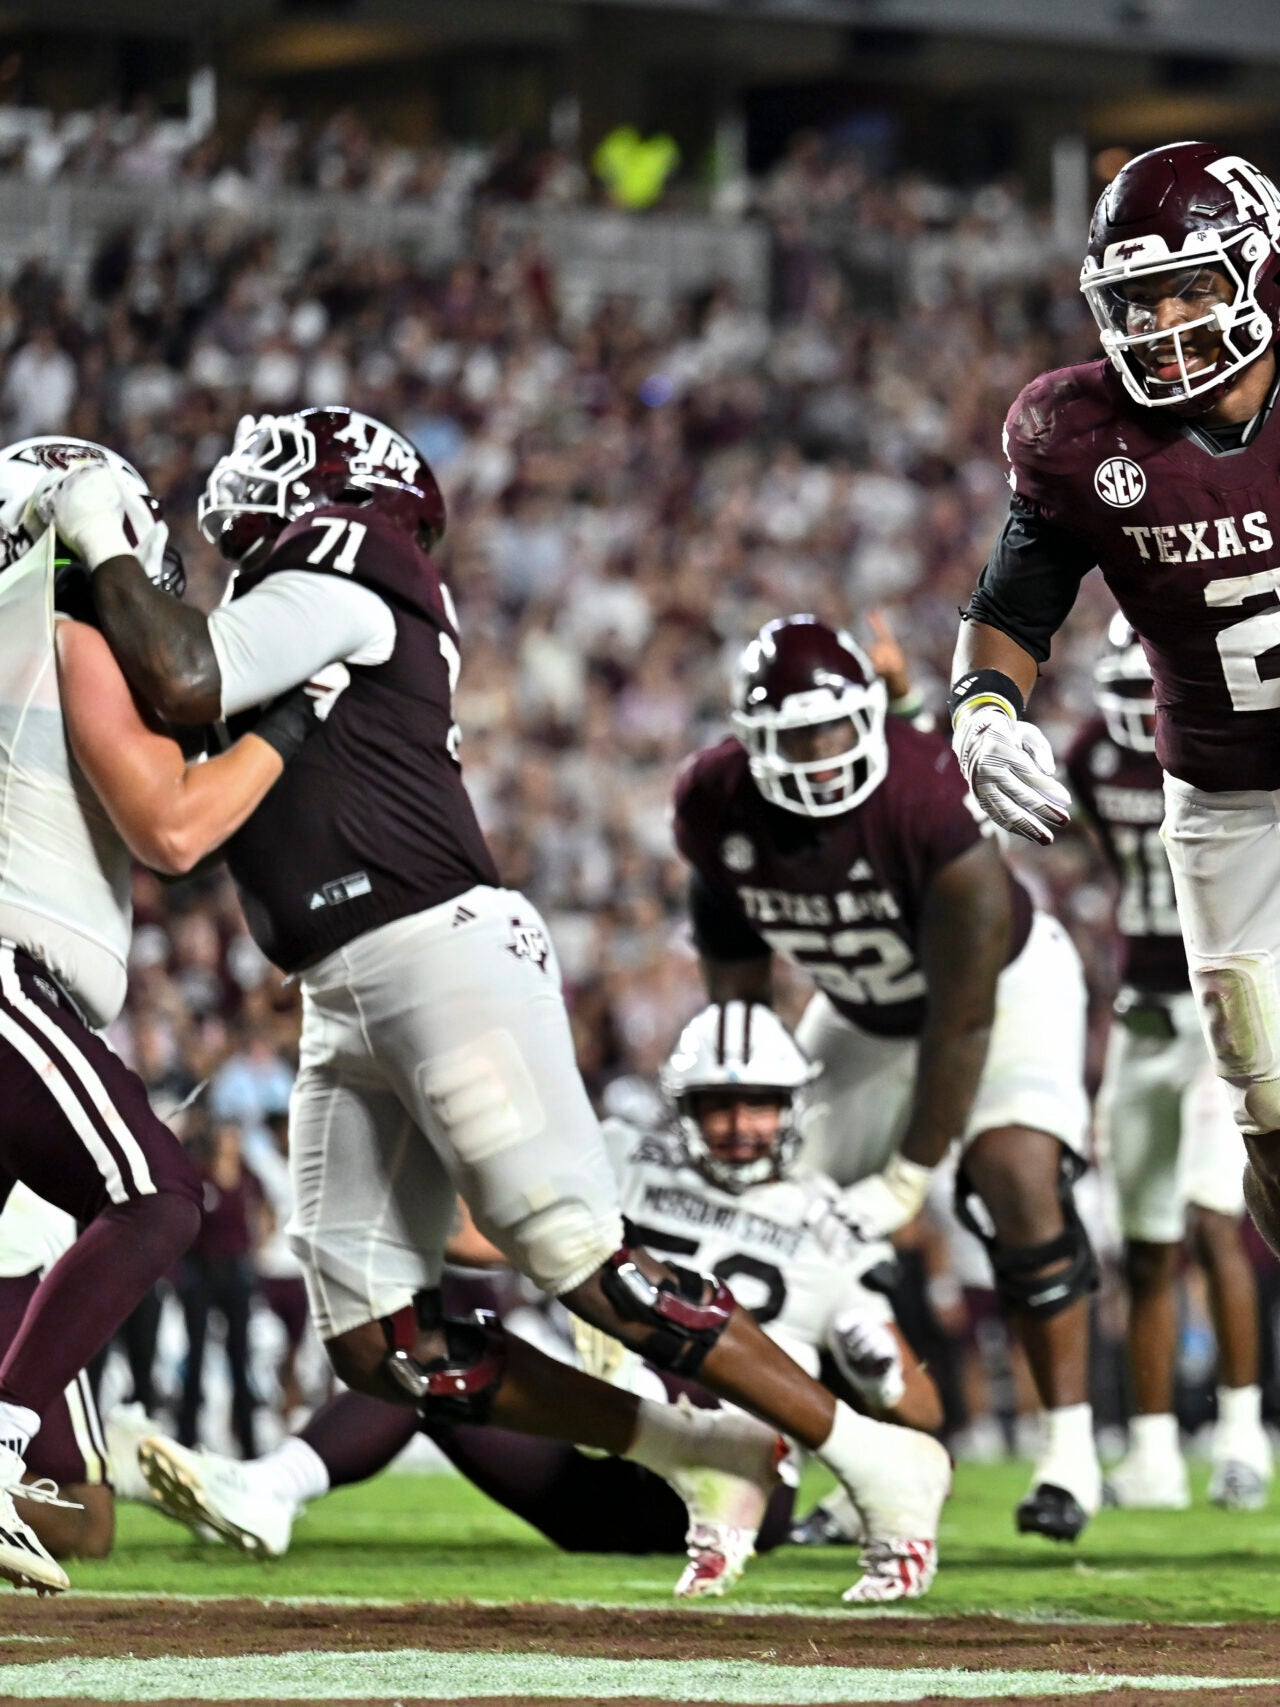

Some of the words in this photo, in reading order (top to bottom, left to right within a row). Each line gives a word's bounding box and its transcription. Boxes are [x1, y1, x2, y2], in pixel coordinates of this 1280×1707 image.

[1098, 461, 1143, 504] SEC
[306, 516, 368, 575] 71
[1122, 509, 1274, 564] TEXAS
[760, 927, 928, 1005] 52
